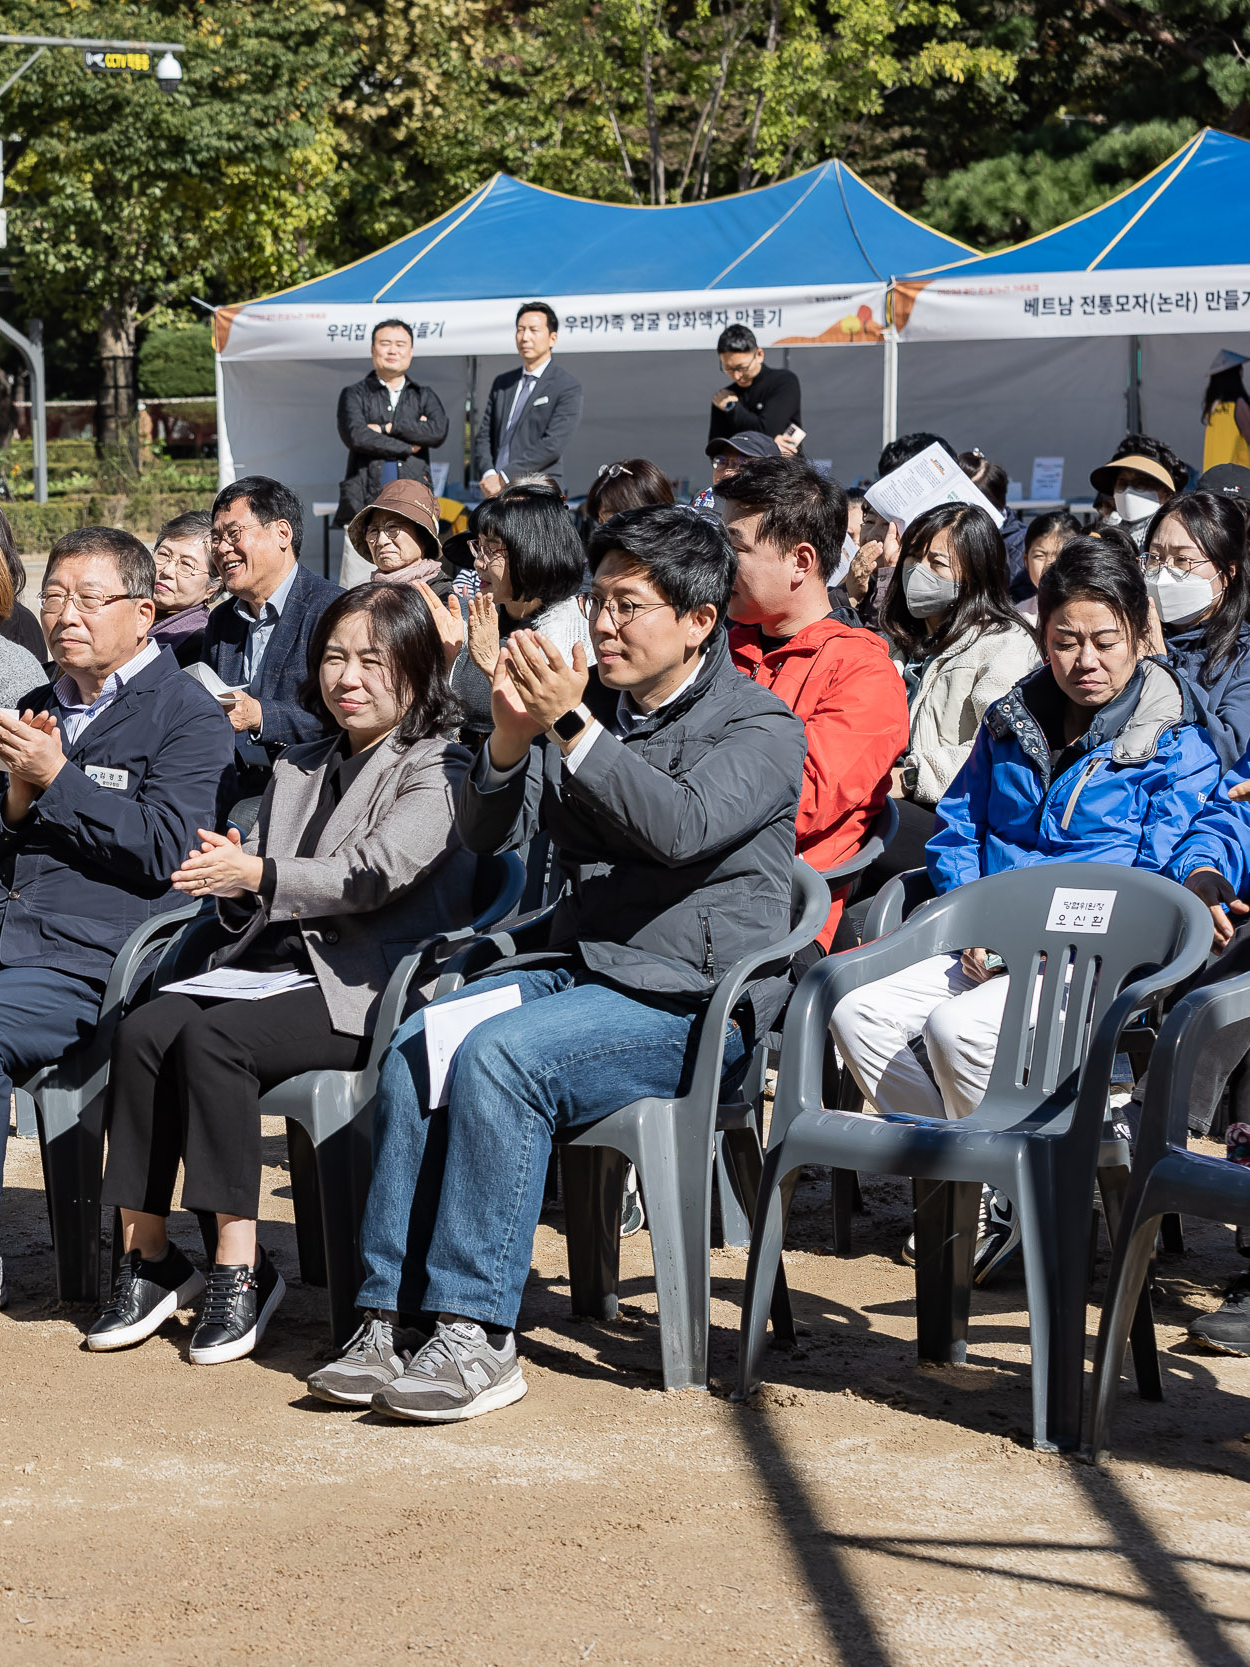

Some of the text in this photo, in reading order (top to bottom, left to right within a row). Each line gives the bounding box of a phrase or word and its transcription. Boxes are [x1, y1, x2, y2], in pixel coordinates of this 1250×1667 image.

[1024, 296, 1073, 317] 베트남
[326, 320, 446, 343] 우리집 들기
[564, 315, 624, 334] 우리가족
[630, 313, 661, 332] 얼굴
[667, 309, 730, 332] 압화액자
